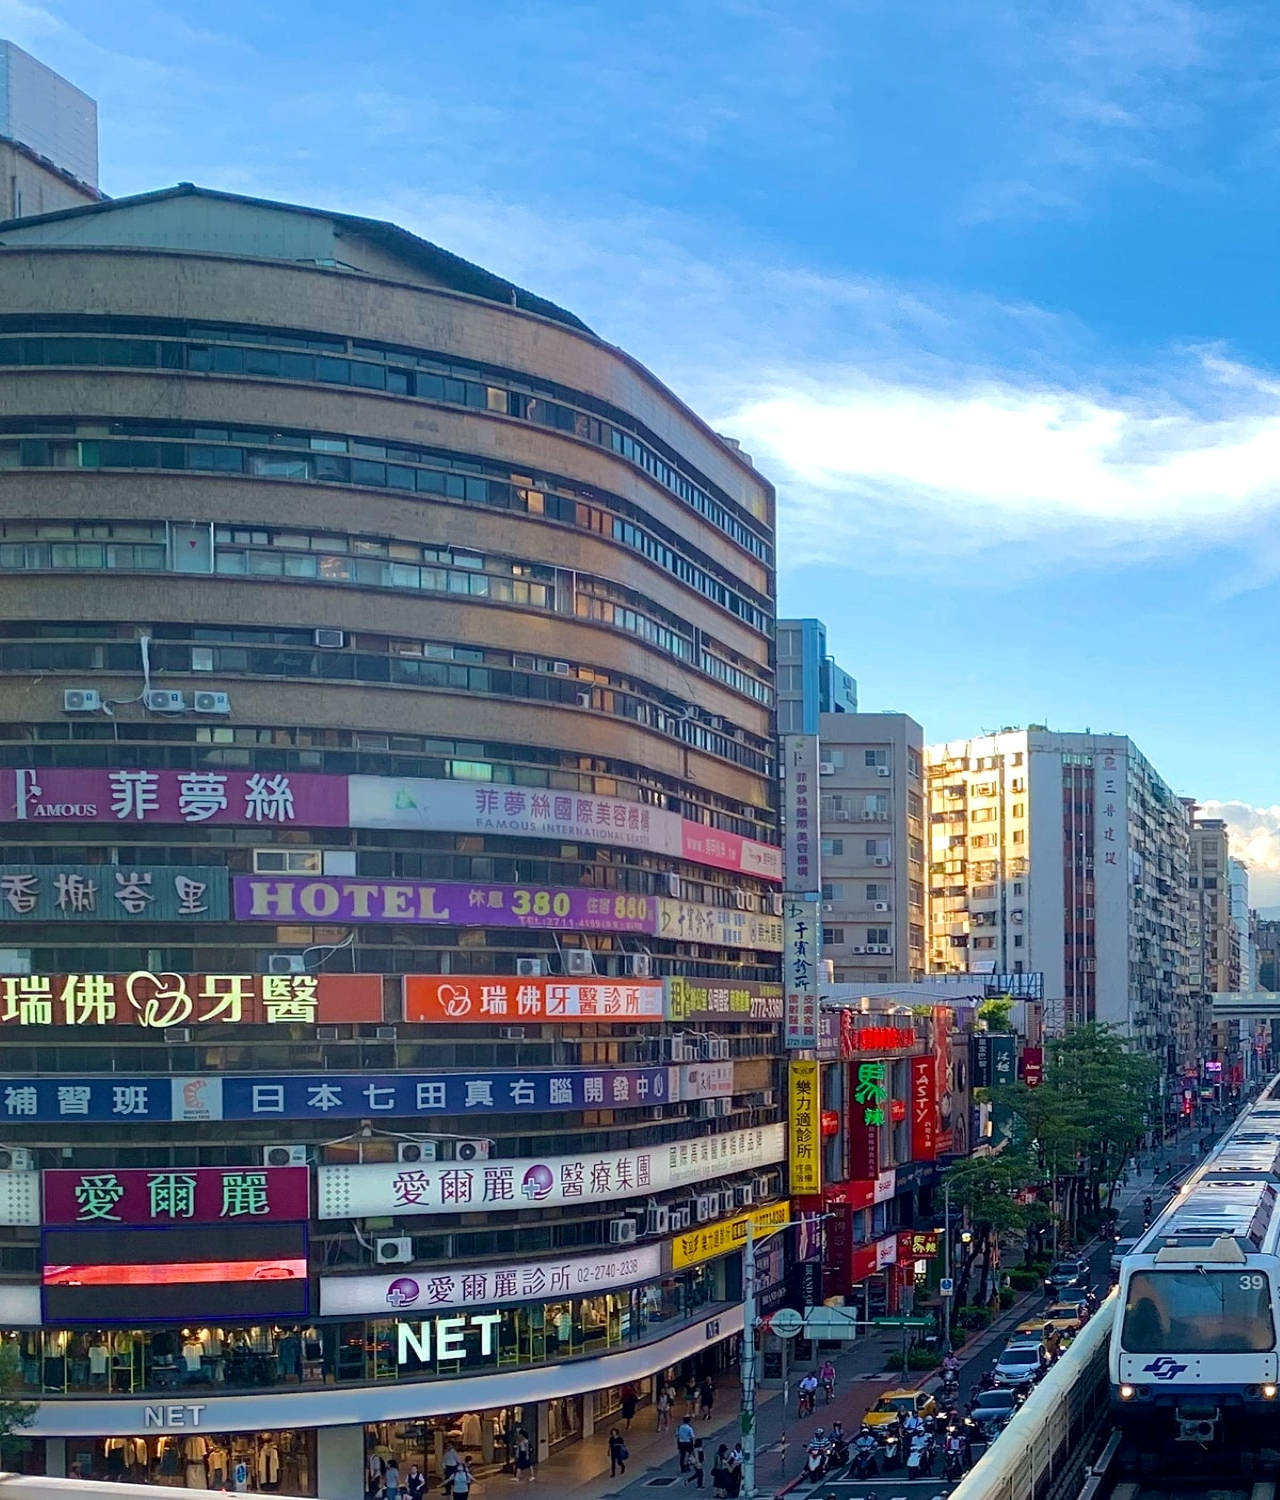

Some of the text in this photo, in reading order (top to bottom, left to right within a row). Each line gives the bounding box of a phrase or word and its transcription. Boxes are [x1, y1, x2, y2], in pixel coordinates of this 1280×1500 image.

[108, 770, 296, 822] 菲夢絲
[475, 817, 537, 833] FAMOUS
[250, 882, 450, 920] HOTEL
[469, 889, 504, 909] 休息
[511, 890, 571, 918] 380
[1, 975, 319, 1025] 瑞佛 牙醫
[480, 984, 642, 1017] 瑞佛牙醫診所
[4, 1086, 149, 1115] 補習班
[252, 1074, 664, 1113] 日本七田真右腦開發中心
[915, 1063, 929, 1123] TASTY
[75, 1172, 271, 1222] 愛爾麗
[392, 1166, 515, 1208] 愛爾麗
[559, 1153, 652, 1197] 醫療集團
[426, 1263, 571, 1304] 愛爾麗診所
[1239, 1275, 1264, 1290] 39
[397, 1315, 502, 1365] NET
[144, 1405, 206, 1427] NET
